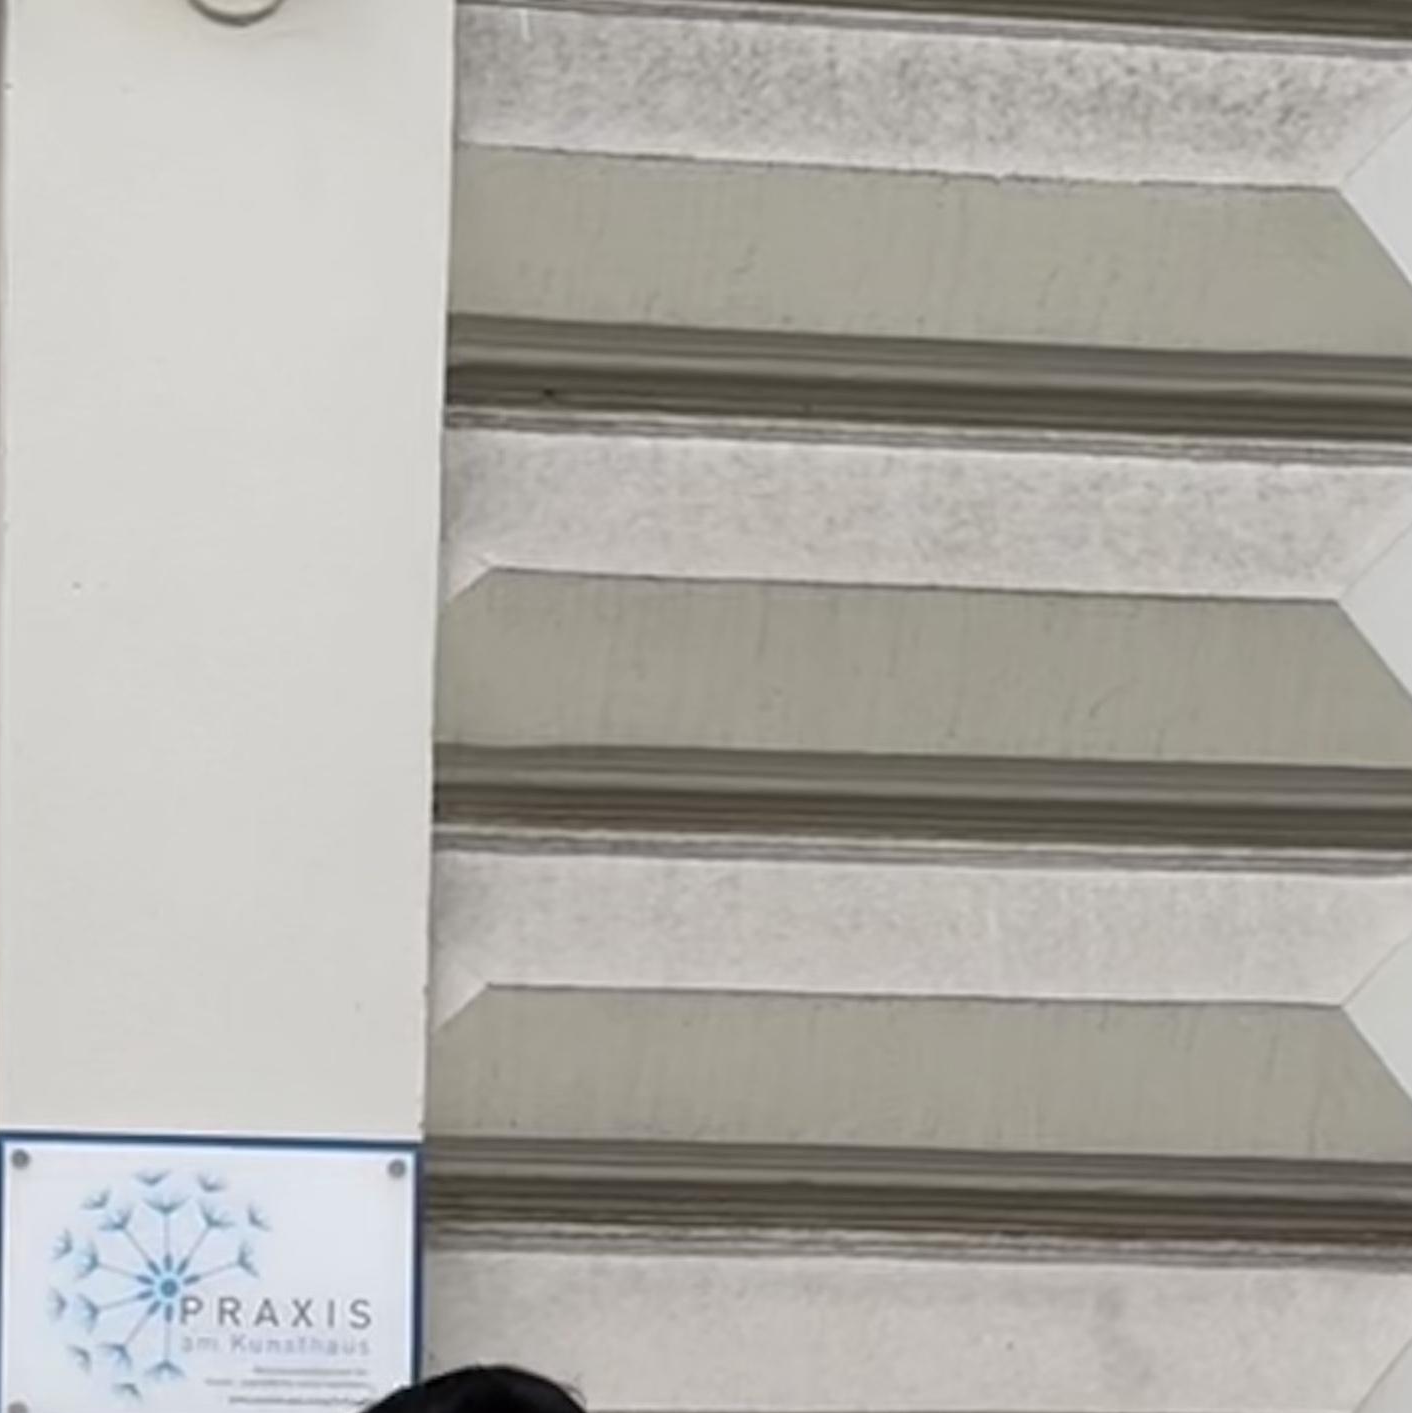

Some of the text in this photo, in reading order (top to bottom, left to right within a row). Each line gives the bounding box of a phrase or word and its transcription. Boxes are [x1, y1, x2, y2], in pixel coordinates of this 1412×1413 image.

[179, 1296, 372, 1330] PRAXIS
[181, 1334, 371, 1356] am Kunsthaus
